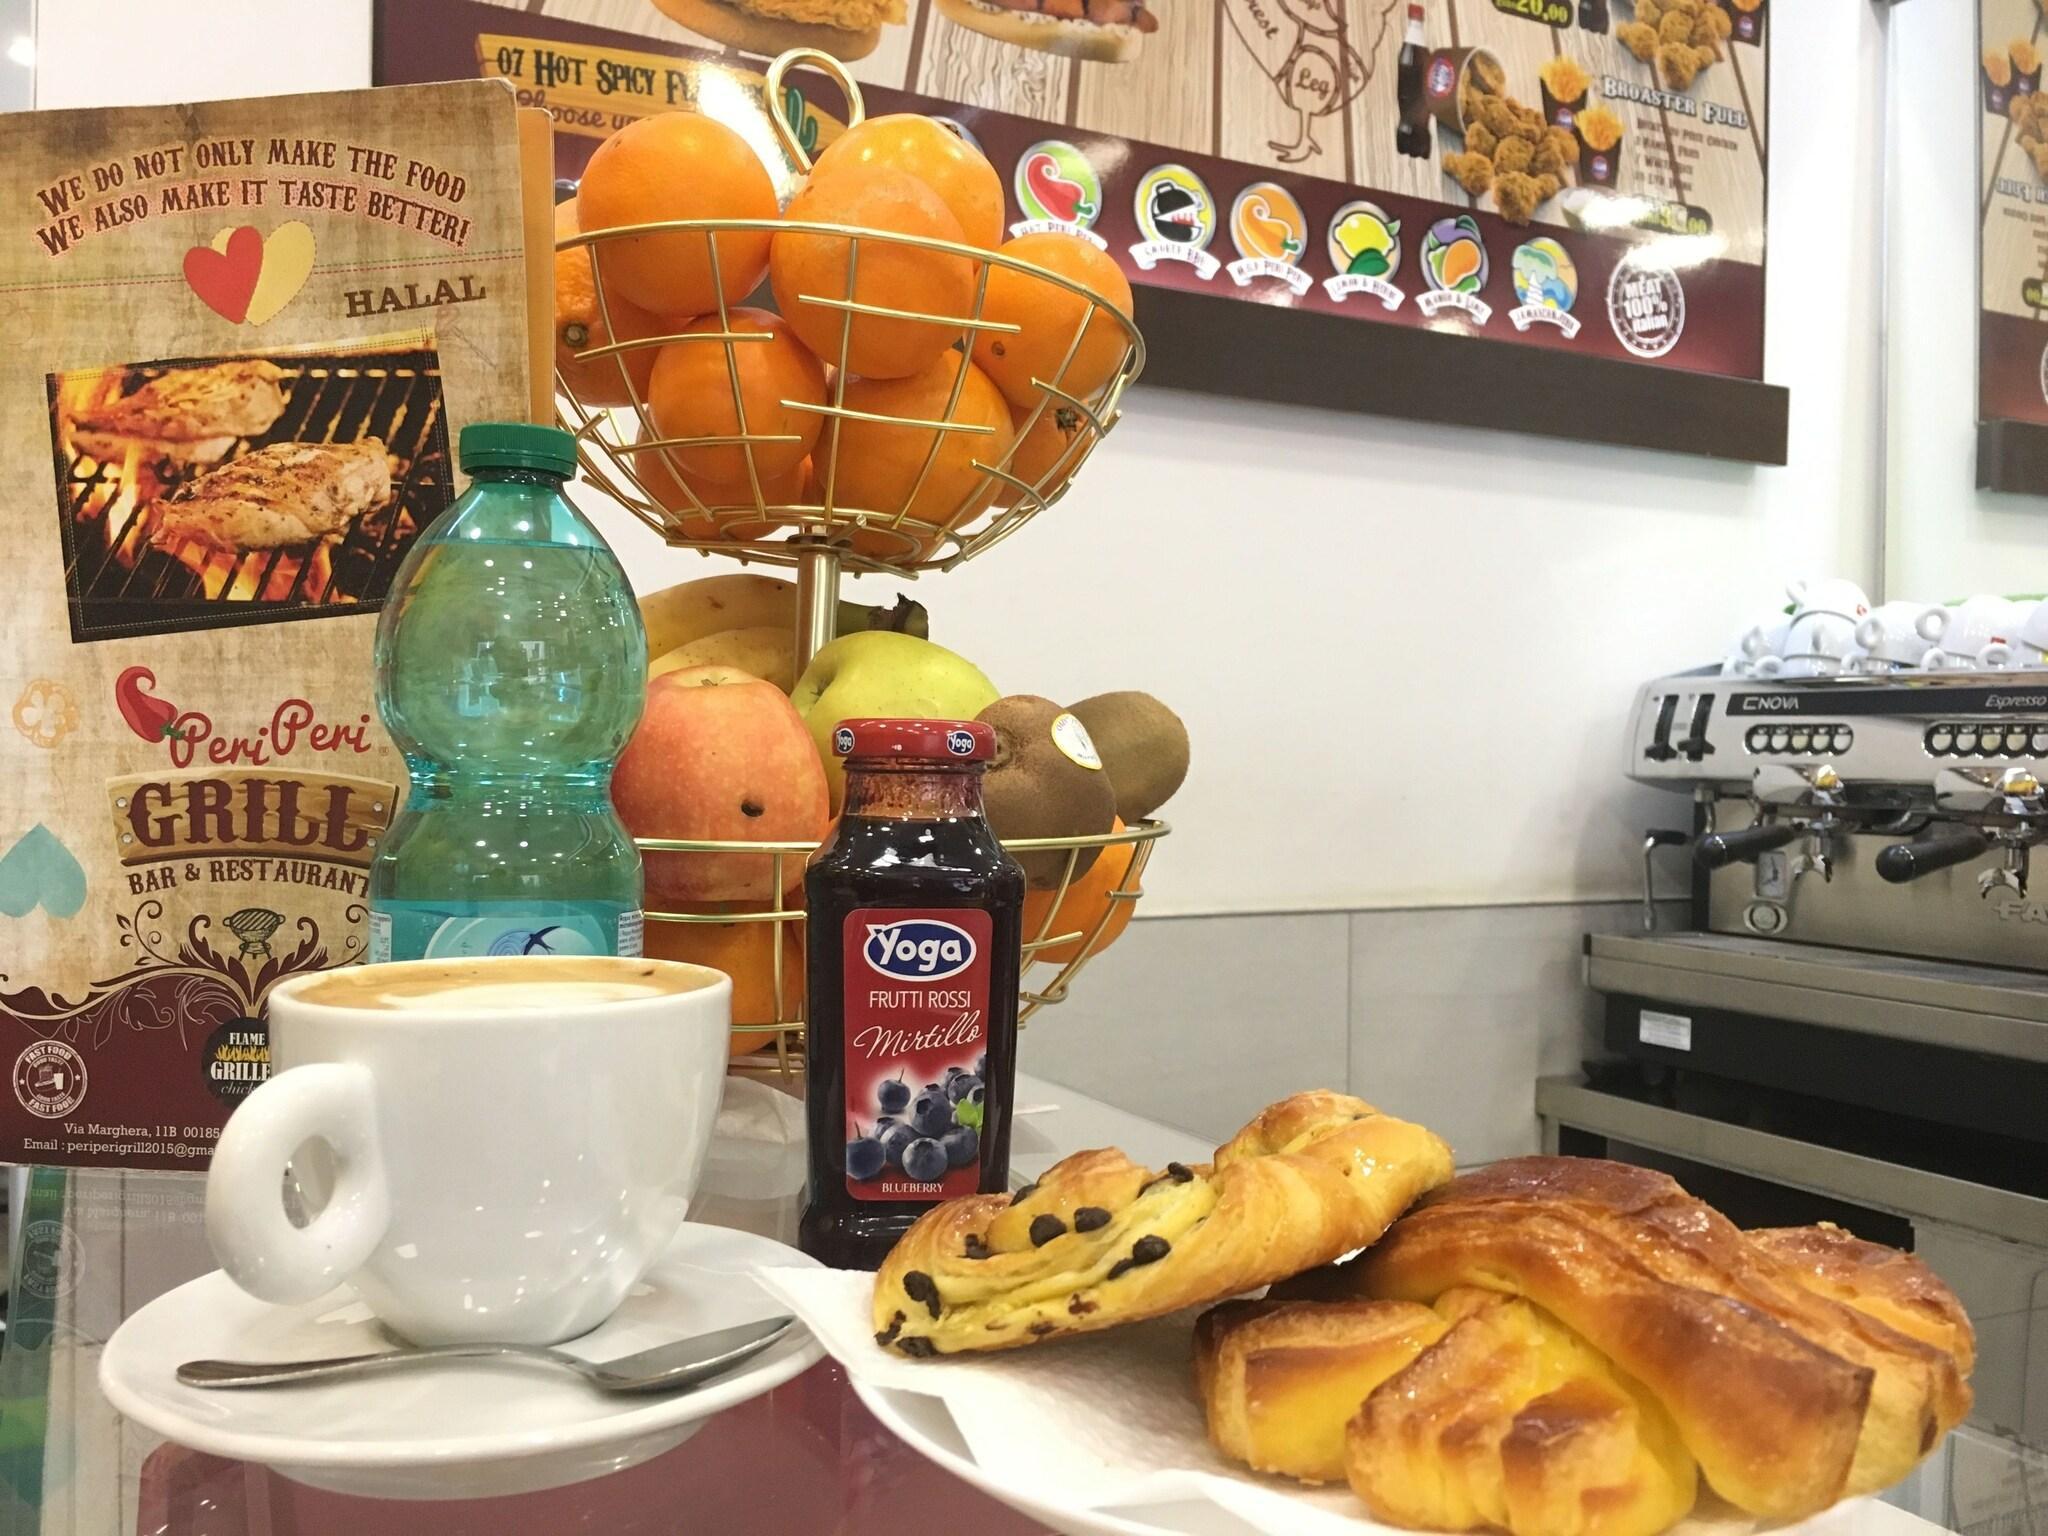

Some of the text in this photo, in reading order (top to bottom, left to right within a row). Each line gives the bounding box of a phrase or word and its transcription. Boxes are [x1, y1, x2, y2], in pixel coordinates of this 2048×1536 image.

[497, 47, 524, 77] 07
[534, 50, 587, 88] HOT
[596, 60, 656, 96] SPICY
[1295, 67, 1330, 100] Leg
[37, 138, 468, 218] WE DO NOT ONLY MAKE THE FOOD
[36, 179, 473, 258] WE ALSO MAKE IT TASTE BETTER!
[344, 275, 488, 319] HALAL
[1623, 295, 1669, 319] 100%
[1985, 694, 2048, 710] Espresso
[836, 731, 852, 751] Yoga
[946, 732, 973, 753] Yoga
[126, 777, 370, 853] GRILL
[127, 858, 370, 900] BAR & RESTAURANT
[868, 924, 963, 974] Yoga
[869, 990, 972, 1009] FRUTTI ROSSI
[229, 1031, 266, 1046] FLAME
[853, 1010, 984, 1060] Mirtillo
[25, 1045, 72, 1064] FAST FOOD
[210, 1060, 271, 1081] GRILLE
[28, 1095, 75, 1113] FAST FOOD
[64, 1122, 220, 1140] Via Marghera, 11B 00185
[23, 1138, 58, 1151] Email
[881, 1181, 945, 1195] BLUEBERRY
